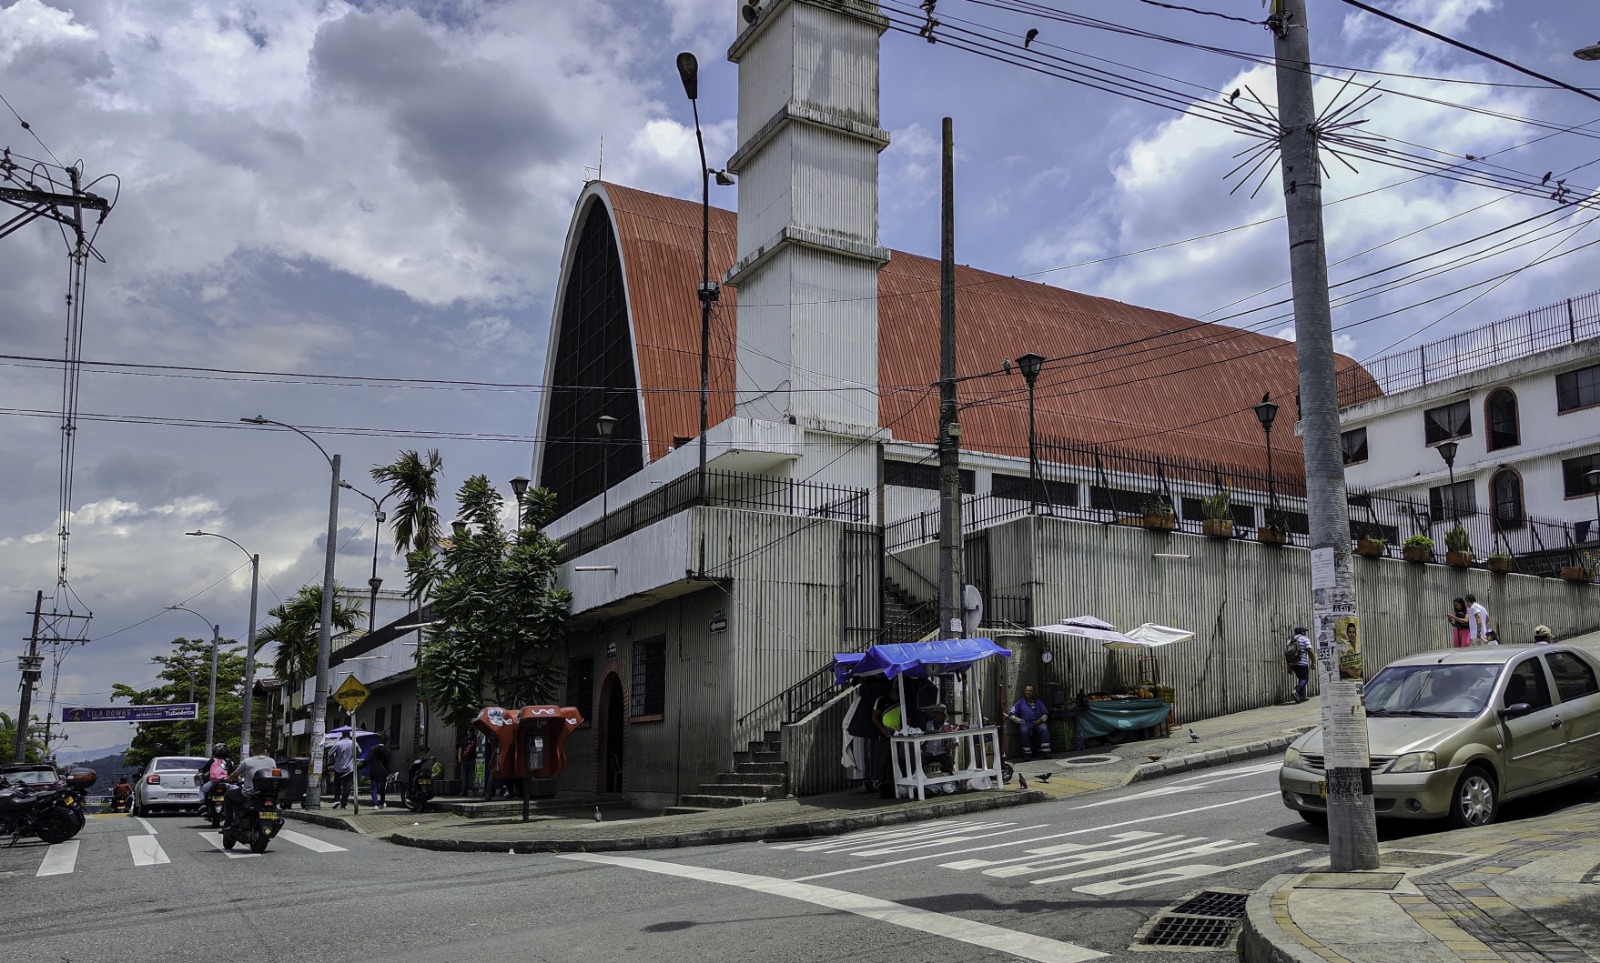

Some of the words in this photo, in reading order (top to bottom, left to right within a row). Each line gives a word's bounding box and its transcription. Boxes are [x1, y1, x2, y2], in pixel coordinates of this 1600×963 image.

[87, 710, 103, 718] LILA
[106, 709, 132, 717] DOWNS
[164, 709, 195, 717] Tuboleta
